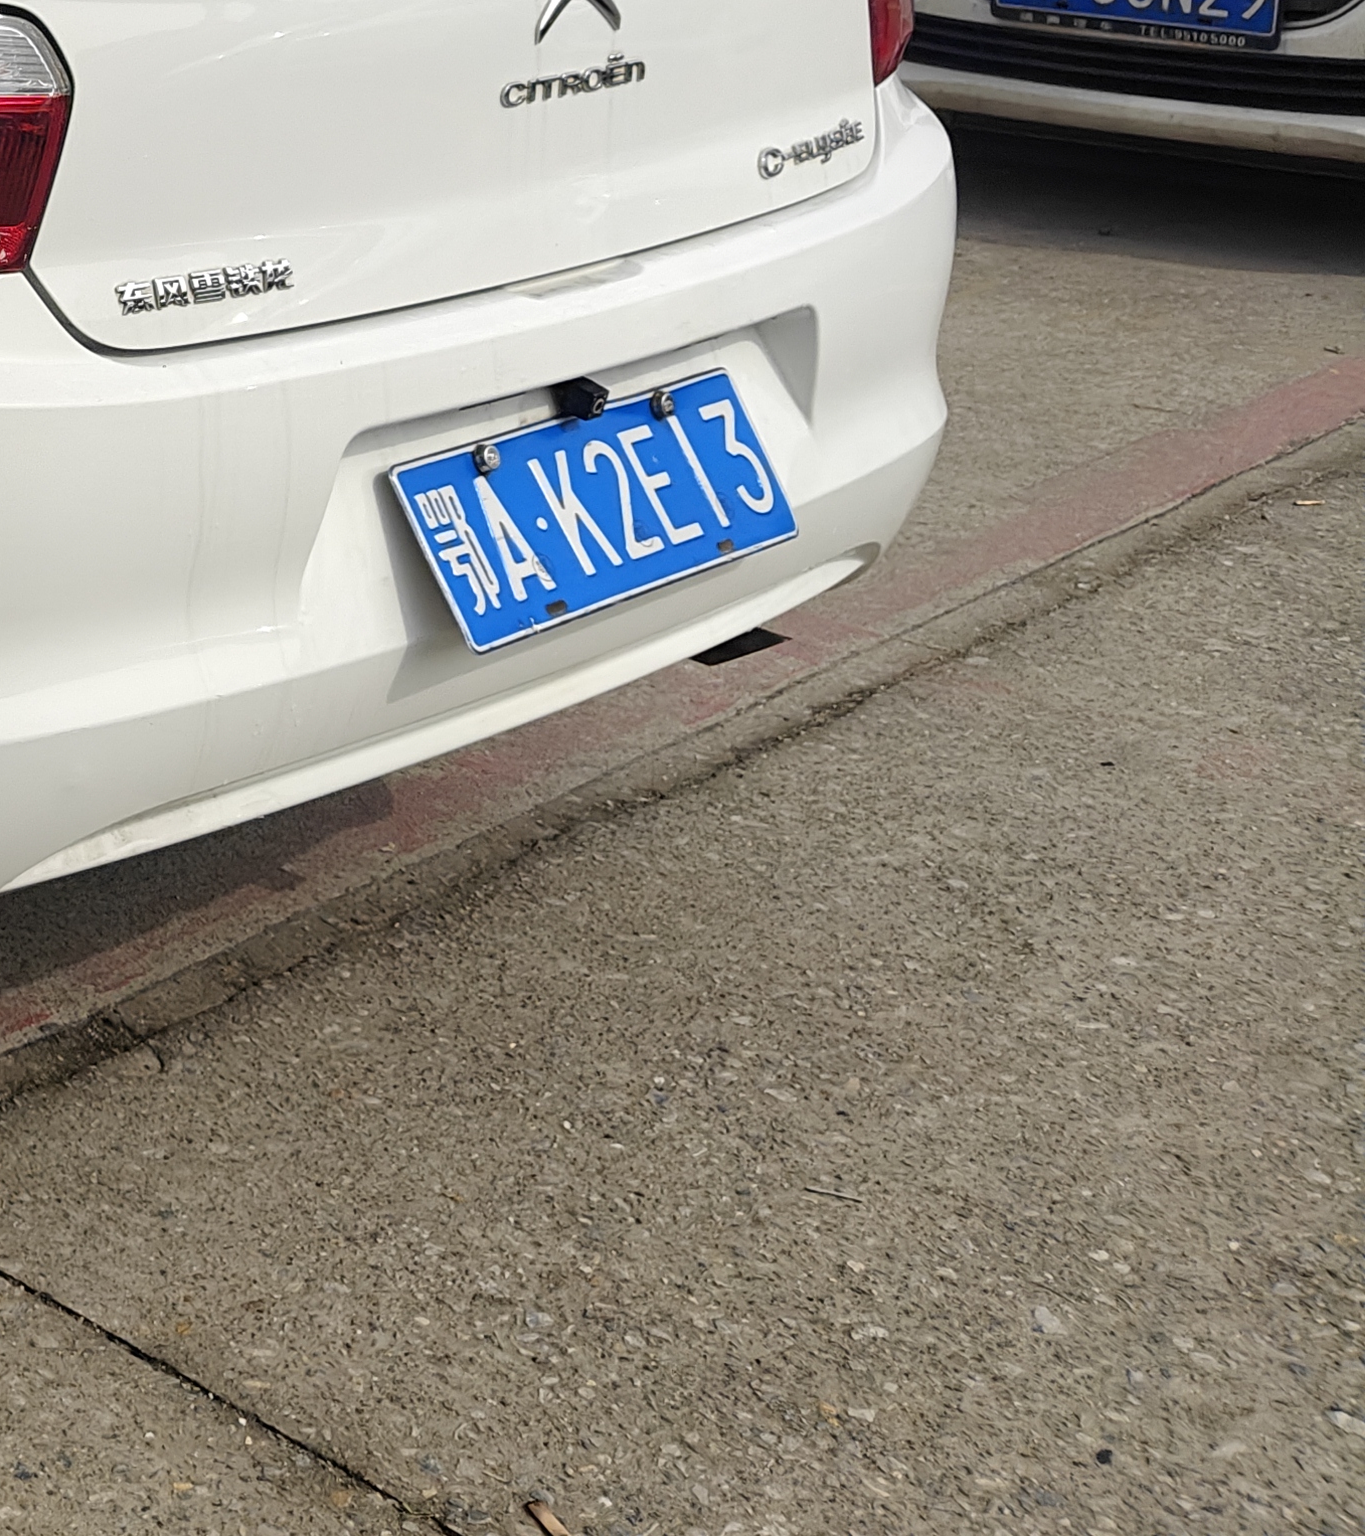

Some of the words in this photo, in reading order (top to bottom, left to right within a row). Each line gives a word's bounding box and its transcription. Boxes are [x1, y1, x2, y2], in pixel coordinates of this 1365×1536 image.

[115, 258, 295, 316] 东风雪铁龙
[413, 398, 776, 616] 鄂A·K2E13
